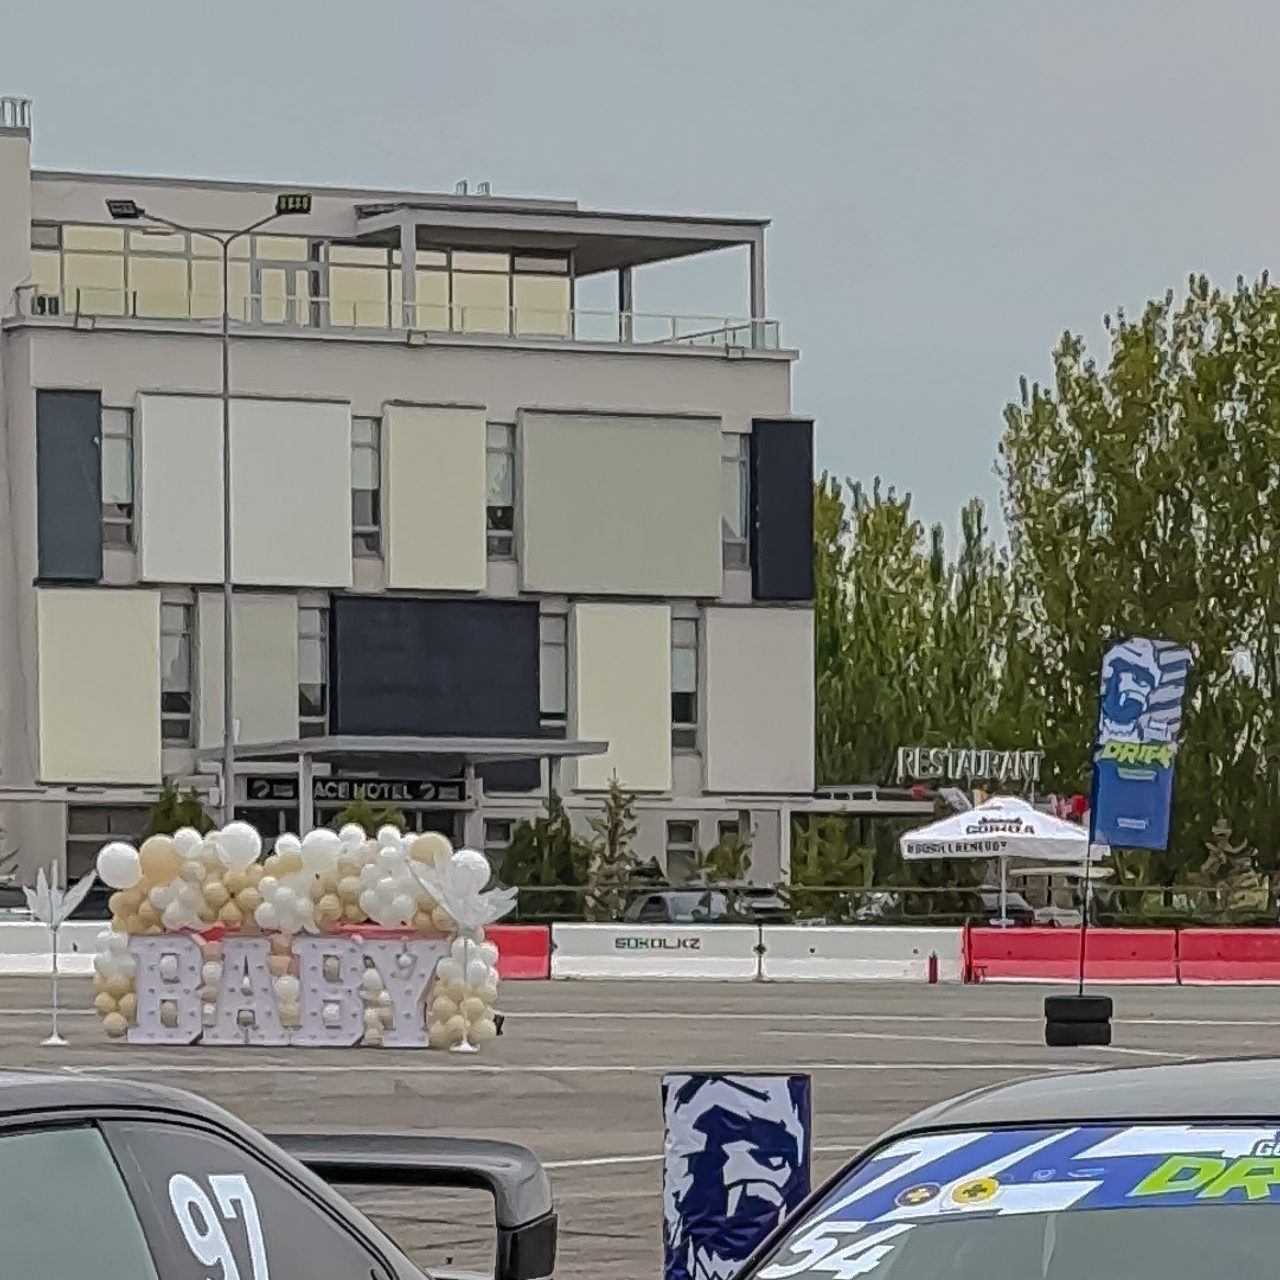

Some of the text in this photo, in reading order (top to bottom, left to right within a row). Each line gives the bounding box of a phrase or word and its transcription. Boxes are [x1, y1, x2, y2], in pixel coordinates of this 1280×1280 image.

[897, 747, 1045, 782] RESTAURANT
[314, 781, 413, 800] ACE HOTEL
[128, 936, 448, 1047] BABY
[757, 1221, 917, 1280] 54
